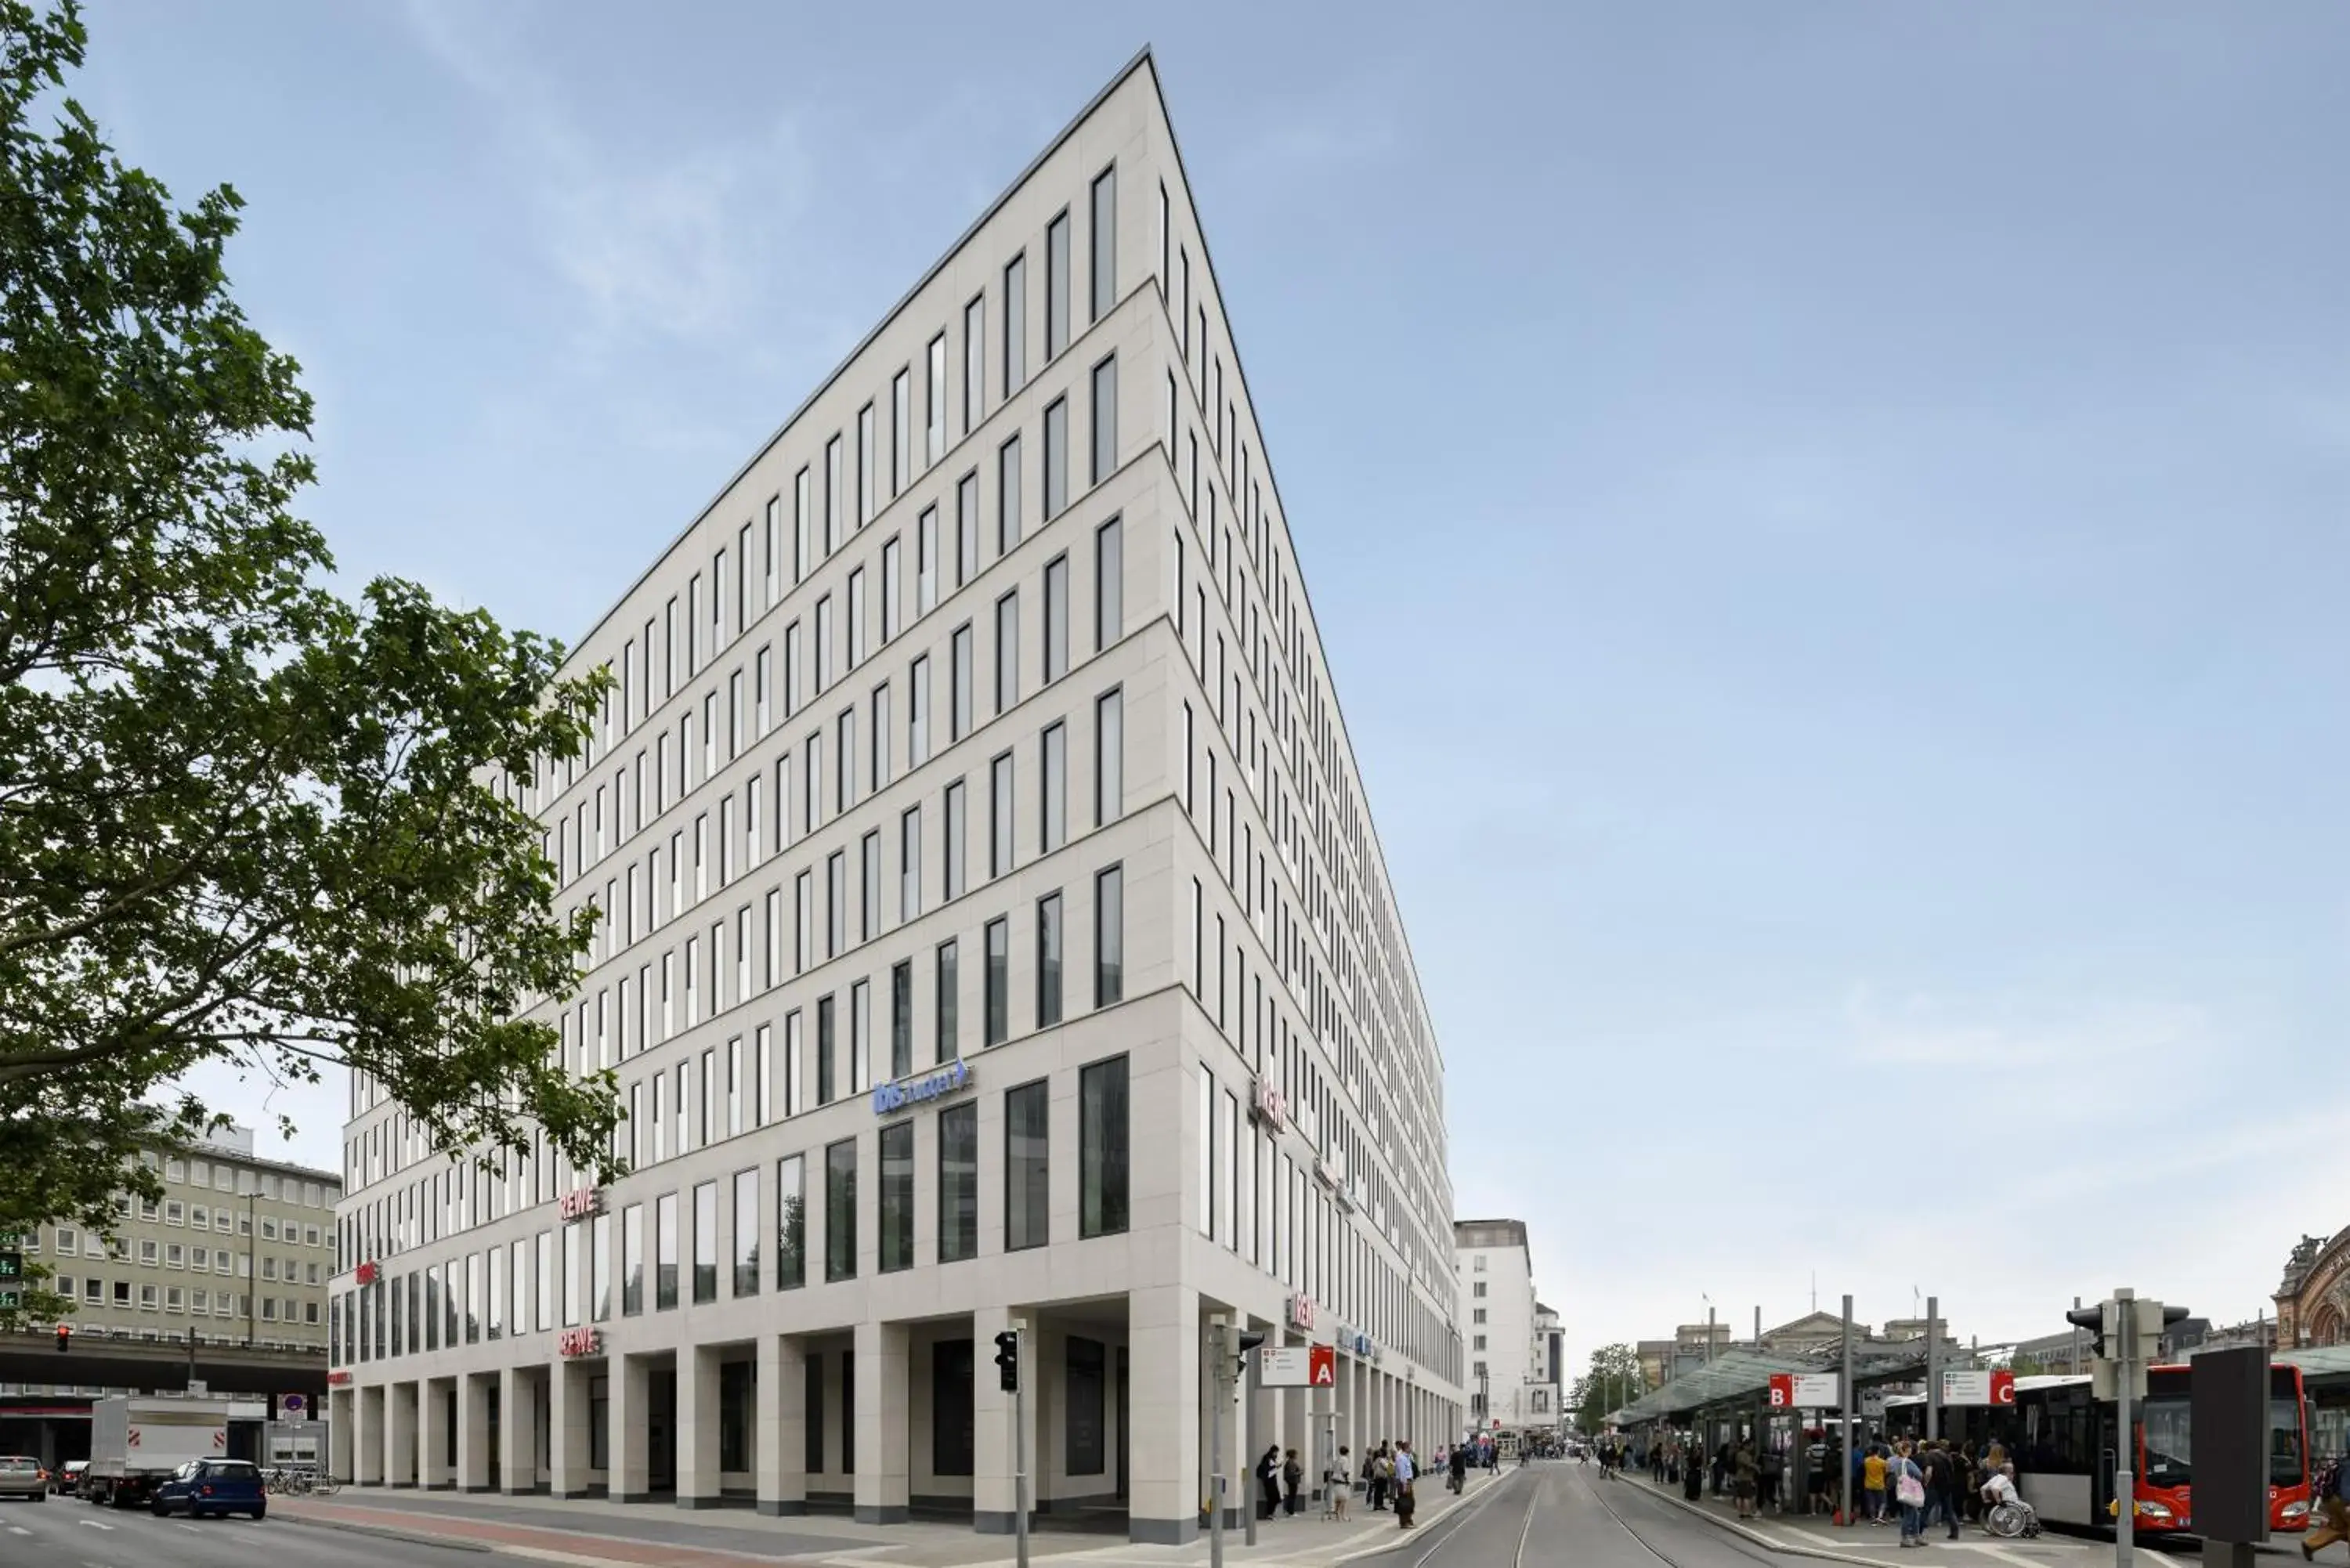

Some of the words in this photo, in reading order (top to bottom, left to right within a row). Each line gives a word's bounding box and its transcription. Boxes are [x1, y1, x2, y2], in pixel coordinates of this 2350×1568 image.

[560, 1186, 596, 1219] REWE
[559, 1328, 596, 1356] REWE
[1316, 1363, 1332, 1383] A
[1771, 1389, 1784, 1405] B
[1998, 1385, 2012, 1403] C
